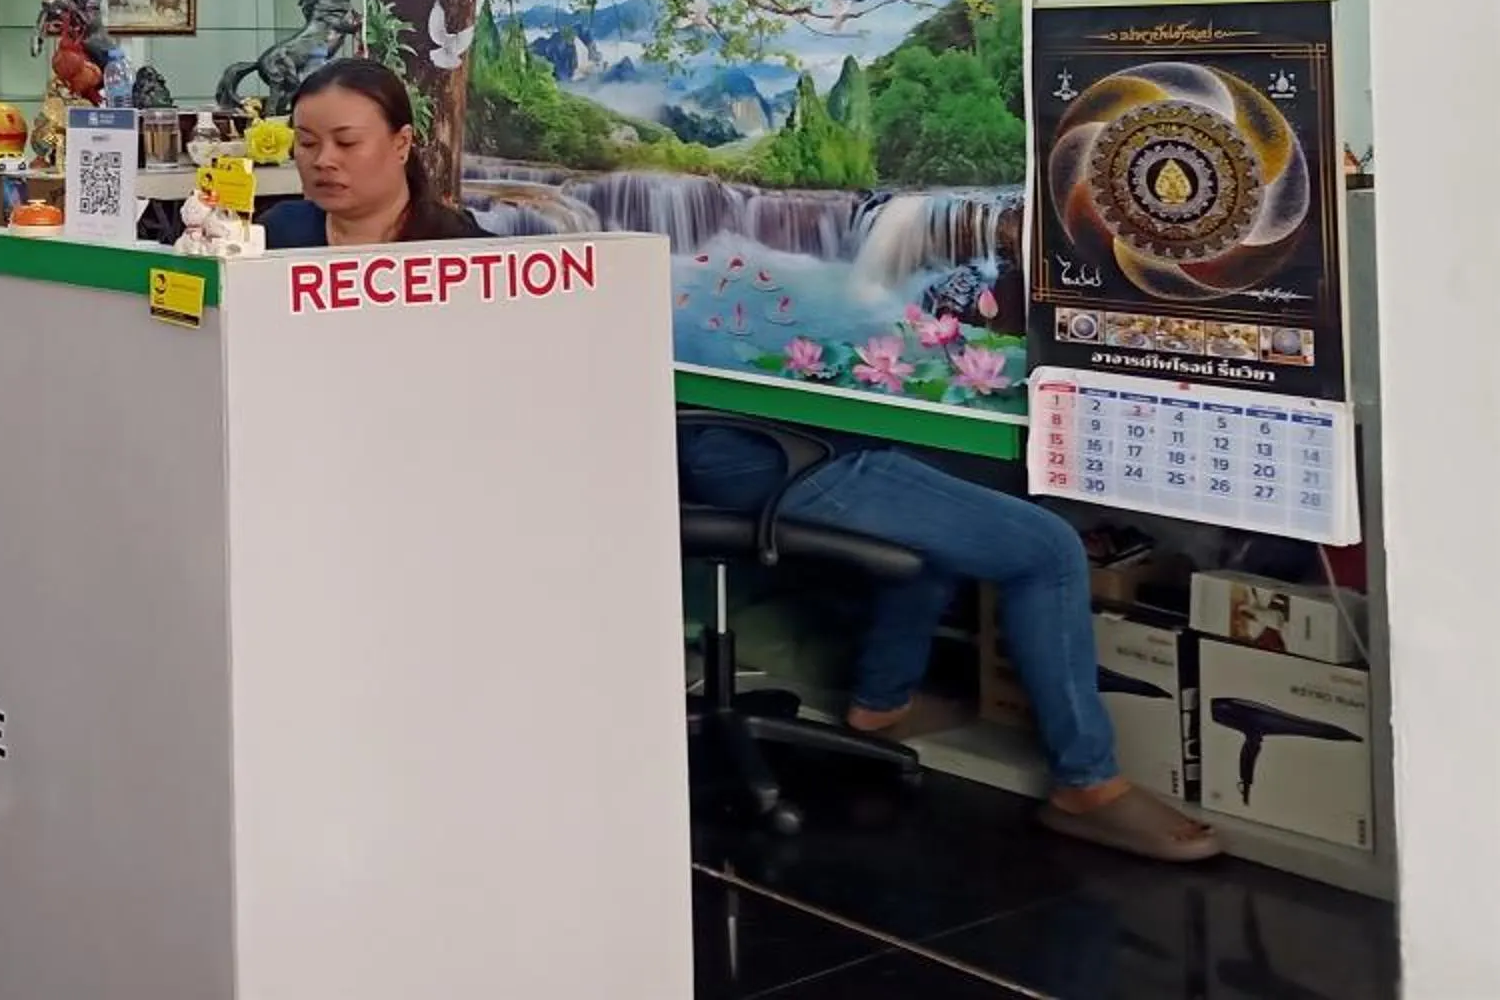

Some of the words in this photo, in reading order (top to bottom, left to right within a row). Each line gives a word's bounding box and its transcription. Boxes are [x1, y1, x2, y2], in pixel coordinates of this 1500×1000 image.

[290, 245, 595, 313] RECEPTION
[1052, 414, 1062, 425] 8
[1091, 420, 1100, 430] 9
[1128, 425, 1145, 438] 10
[1173, 431, 1184, 443] 11
[1214, 437, 1228, 450] 12
[1257, 443, 1272, 456] 13
[1303, 450, 1320, 462] 14
[1054, 394, 1059, 405] 1
[1092, 400, 1100, 410] 2
[1174, 411, 1184, 422] 4
[1217, 417, 1227, 429] 5
[1260, 422, 1271, 434] 6
[1307, 428, 1315, 440] 7
[1049, 472, 1066, 485] 29
[1085, 478, 1105, 492] 30
[1050, 452, 1064, 465] 22
[1086, 458, 1103, 471] 23
[1125, 465, 1143, 478] 24
[1168, 472, 1185, 485] 25
[1210, 478, 1231, 493] 26
[1254, 485, 1274, 498] 27
[1300, 492, 1321, 506] 28
[1051, 434, 1063, 445] 15
[1088, 439, 1102, 451] 16
[1128, 445, 1143, 457] 17
[1168, 451, 1185, 465] 18
[1212, 458, 1229, 471] 19
[1253, 464, 1275, 478] 20
[1303, 471, 1319, 483] 21
